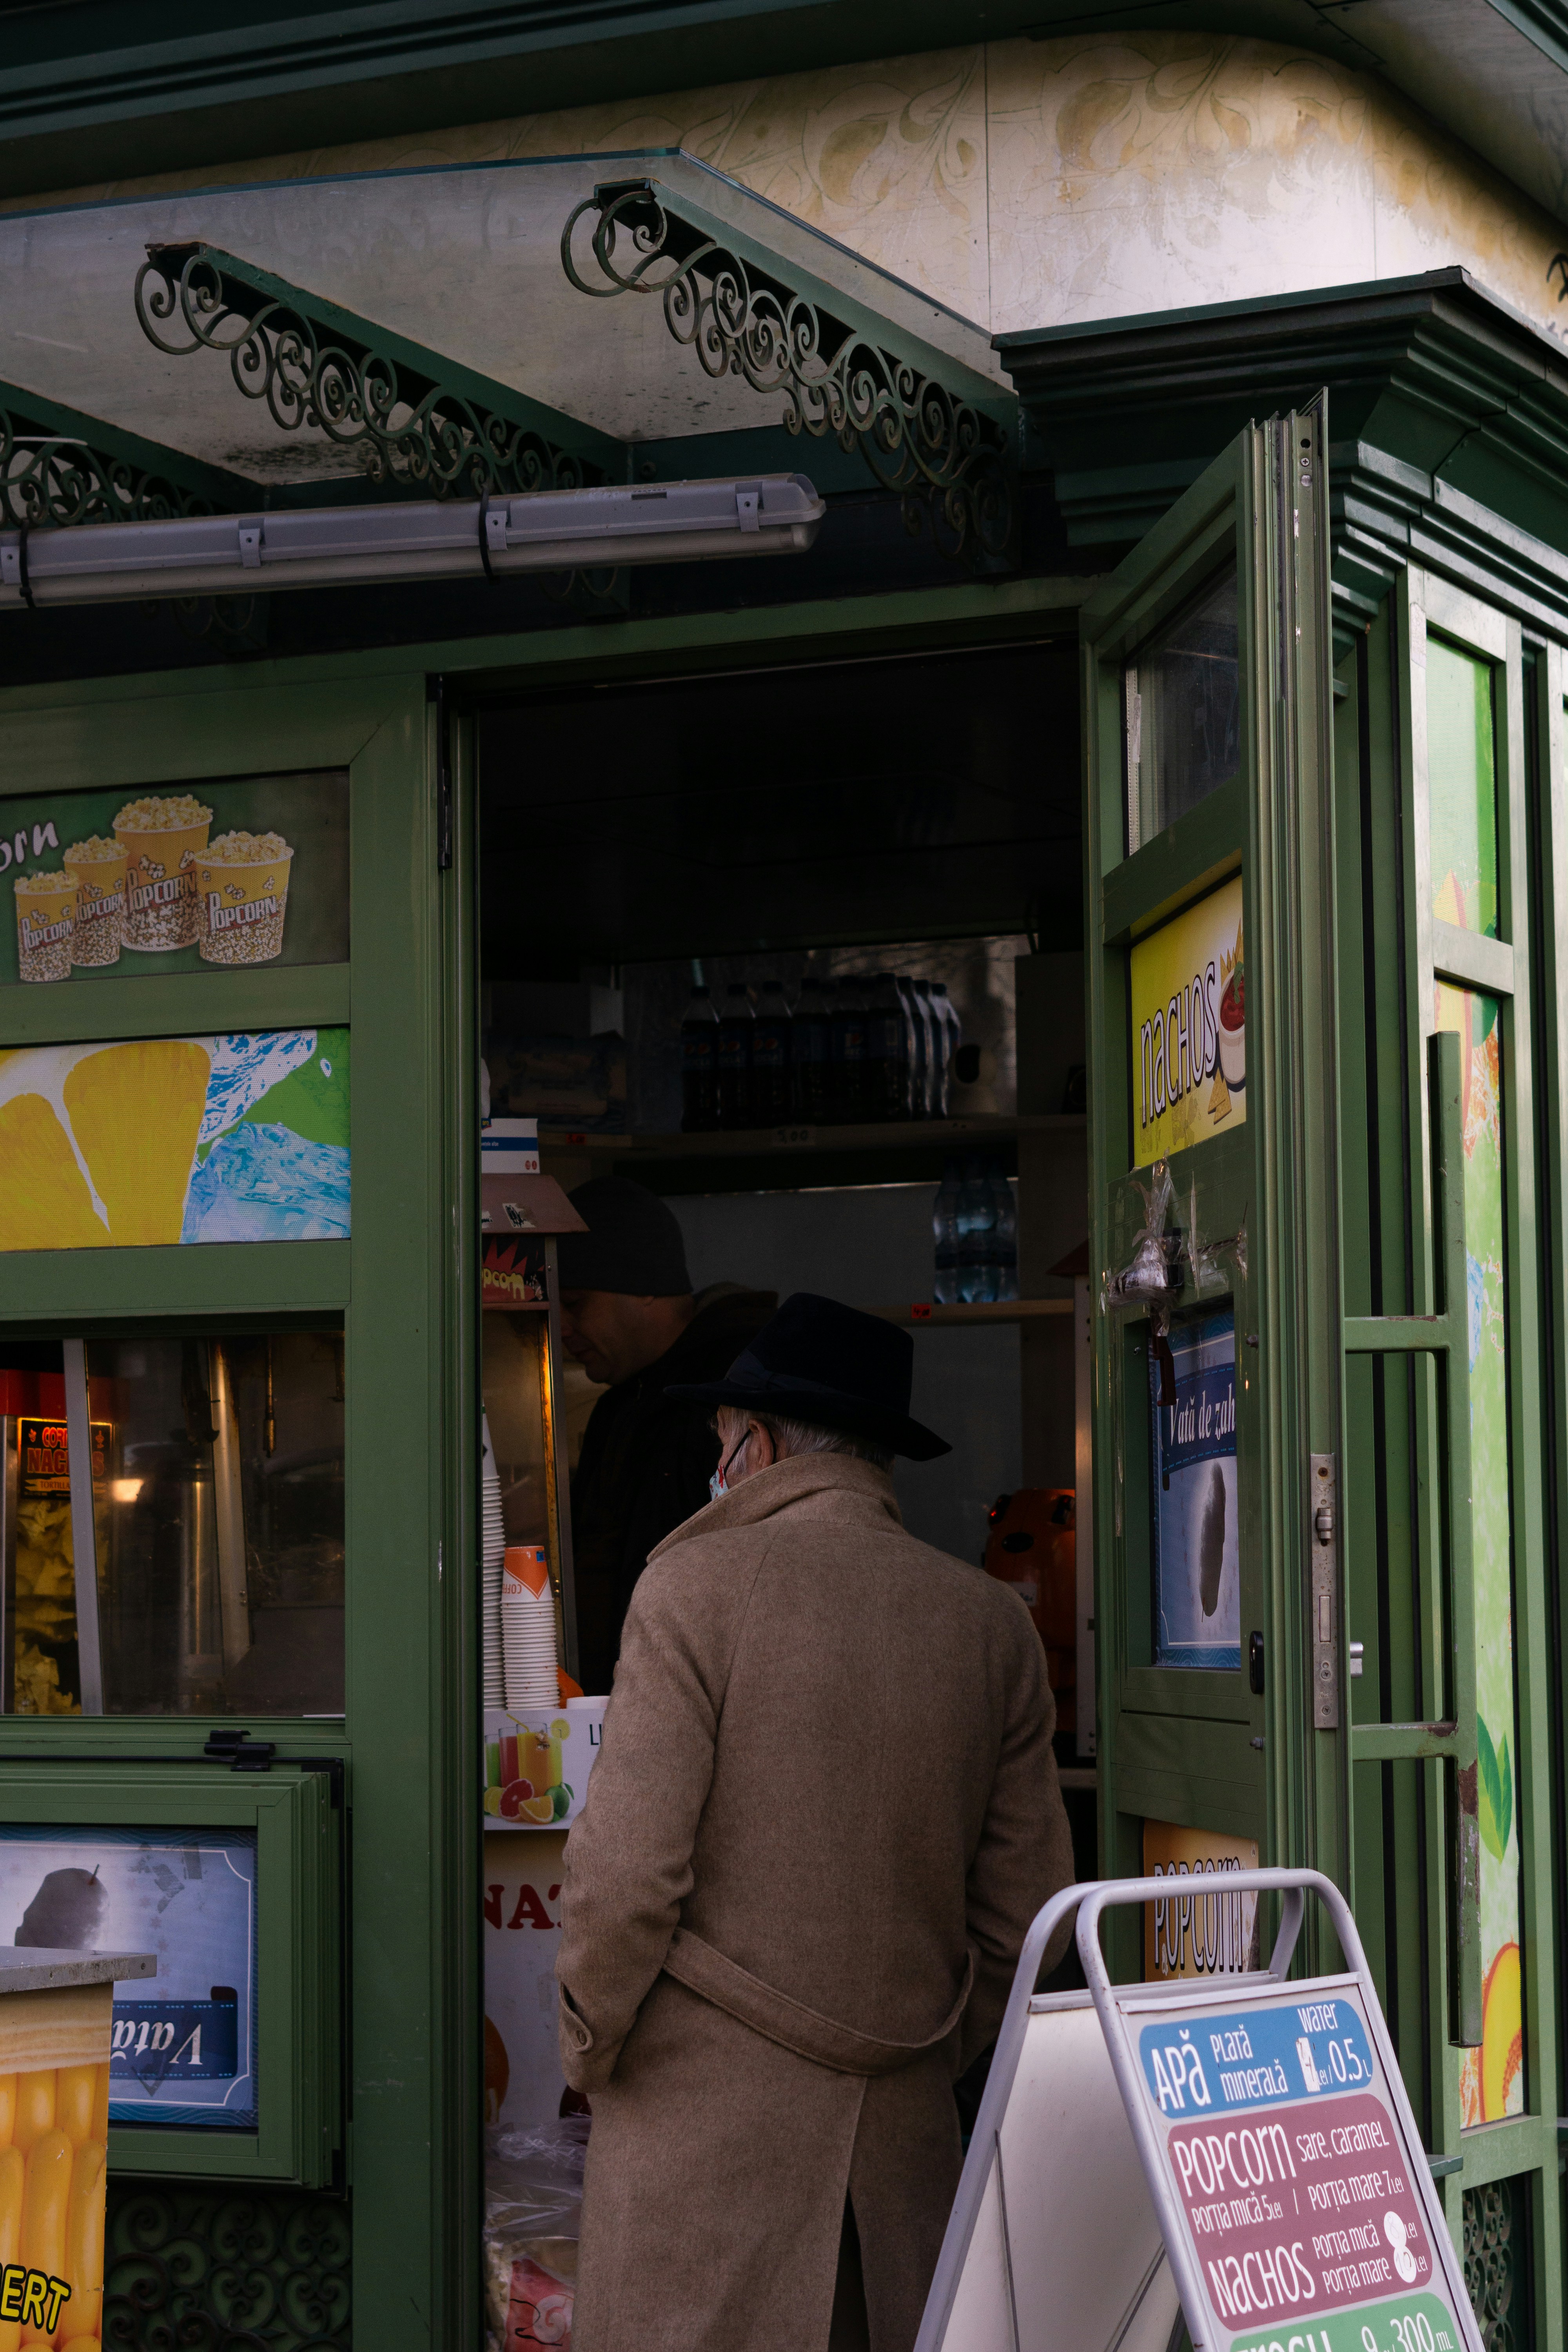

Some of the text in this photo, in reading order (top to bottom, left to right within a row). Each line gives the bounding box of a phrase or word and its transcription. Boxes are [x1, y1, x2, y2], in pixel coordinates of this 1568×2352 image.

[208, 893, 277, 931] POPCORN
[1198, 1390, 1212, 1440] de
[1348, 2172, 1385, 2202] mare
[1359, 2257, 1392, 2285] mare
[0, 2263, 72, 2335] ERT
